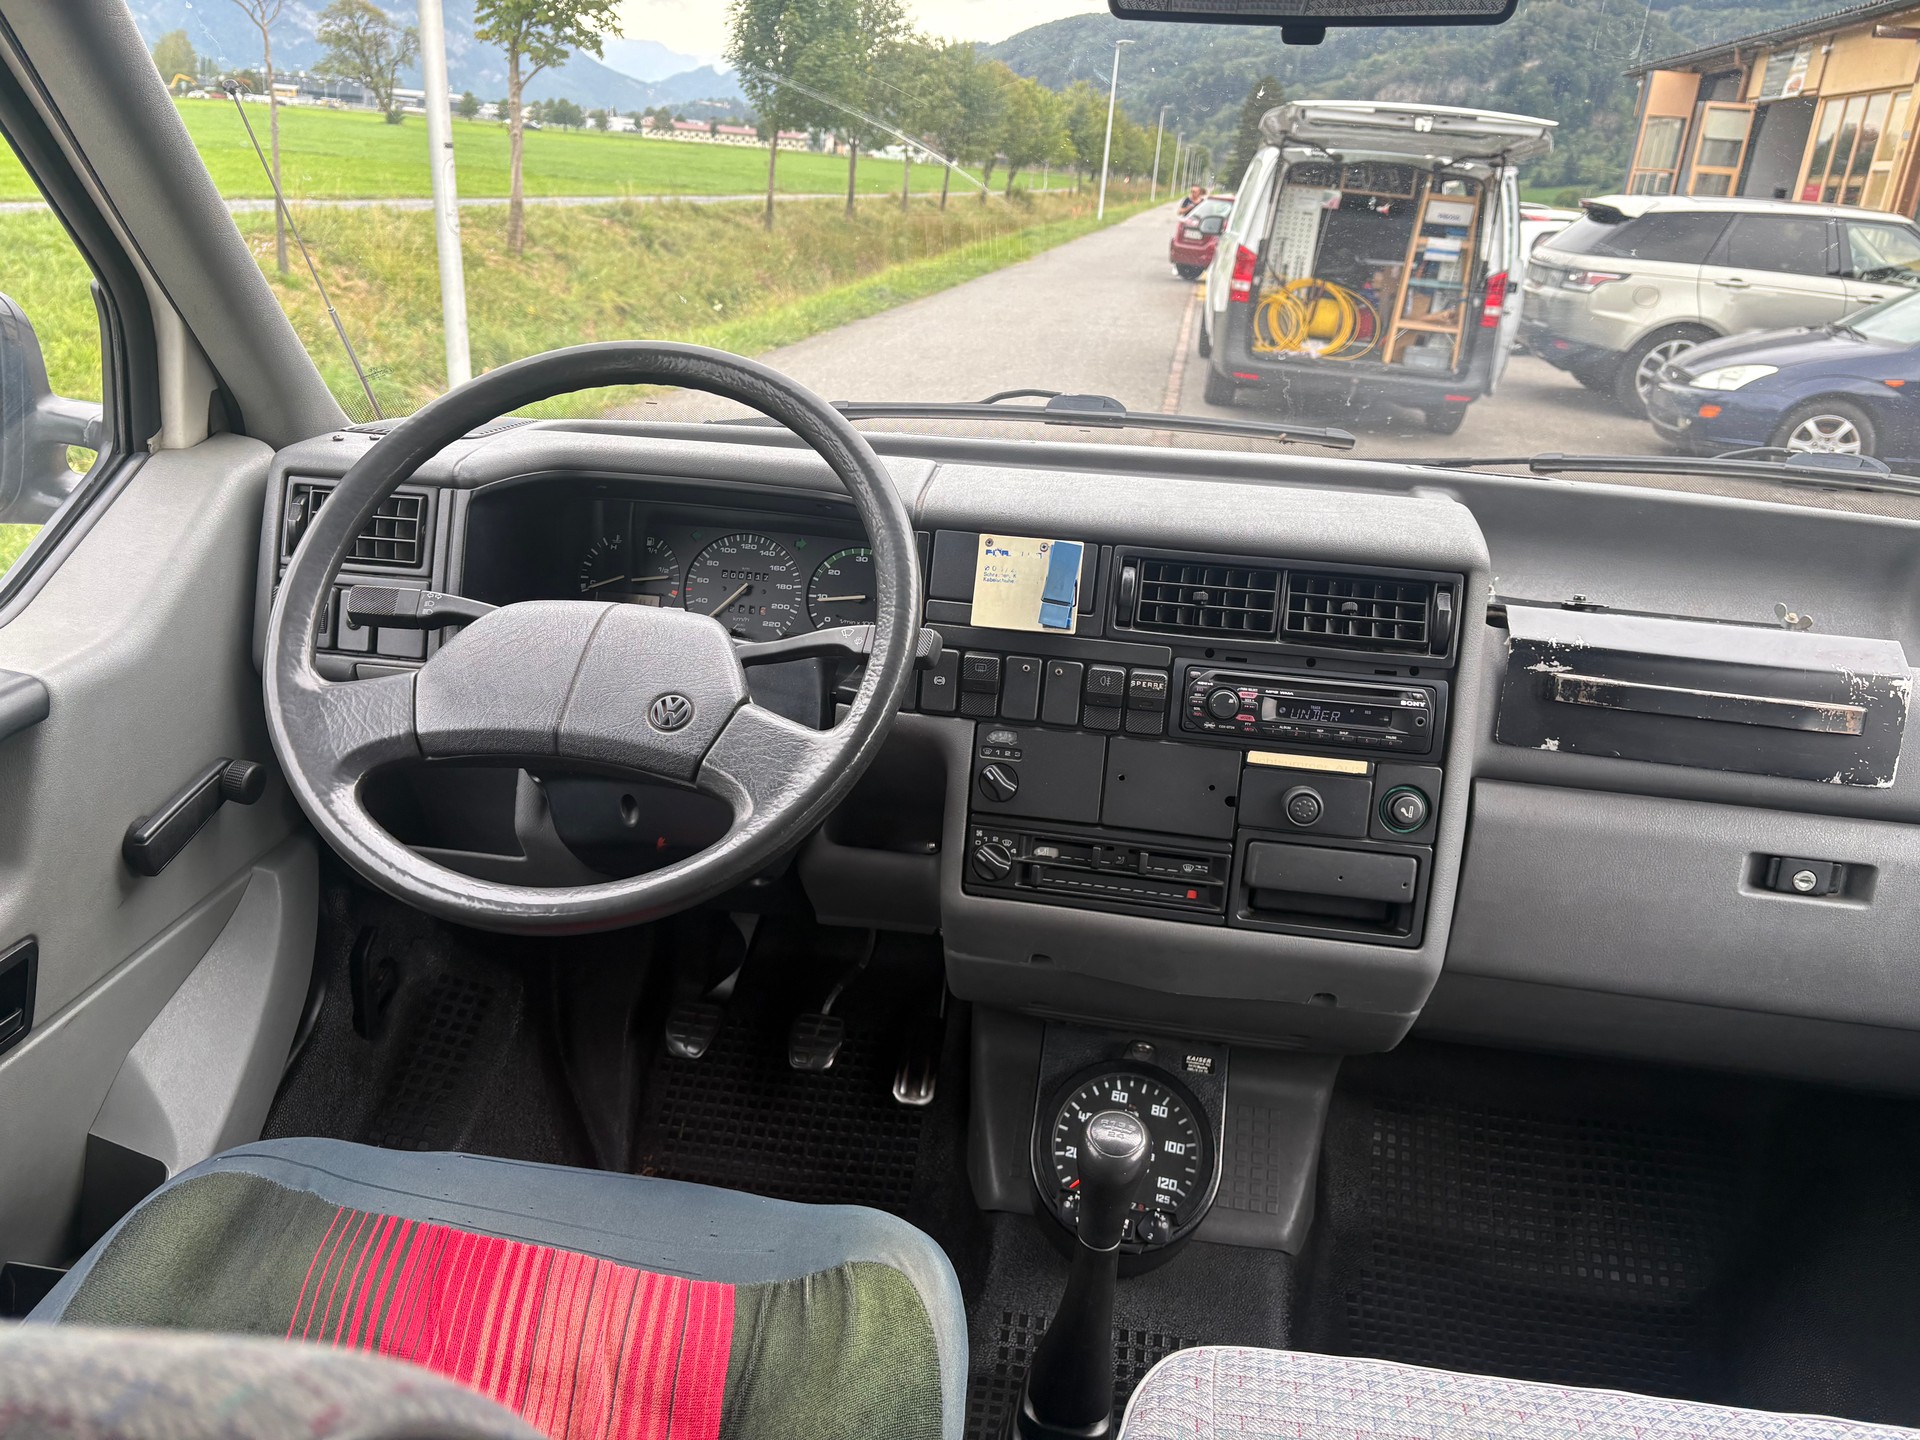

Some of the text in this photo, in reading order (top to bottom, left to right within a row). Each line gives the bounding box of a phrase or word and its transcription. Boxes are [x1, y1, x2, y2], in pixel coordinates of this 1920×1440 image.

[762, 620, 780, 628] 220
[1290, 707, 1341, 722] UNDER
[1111, 1090, 1128, 1104] 60
[1150, 1104, 1169, 1118] 80
[1164, 1140, 1185, 1155] 100
[1157, 1176, 1177, 1191] 120
[1155, 1193, 1171, 1205] 125
